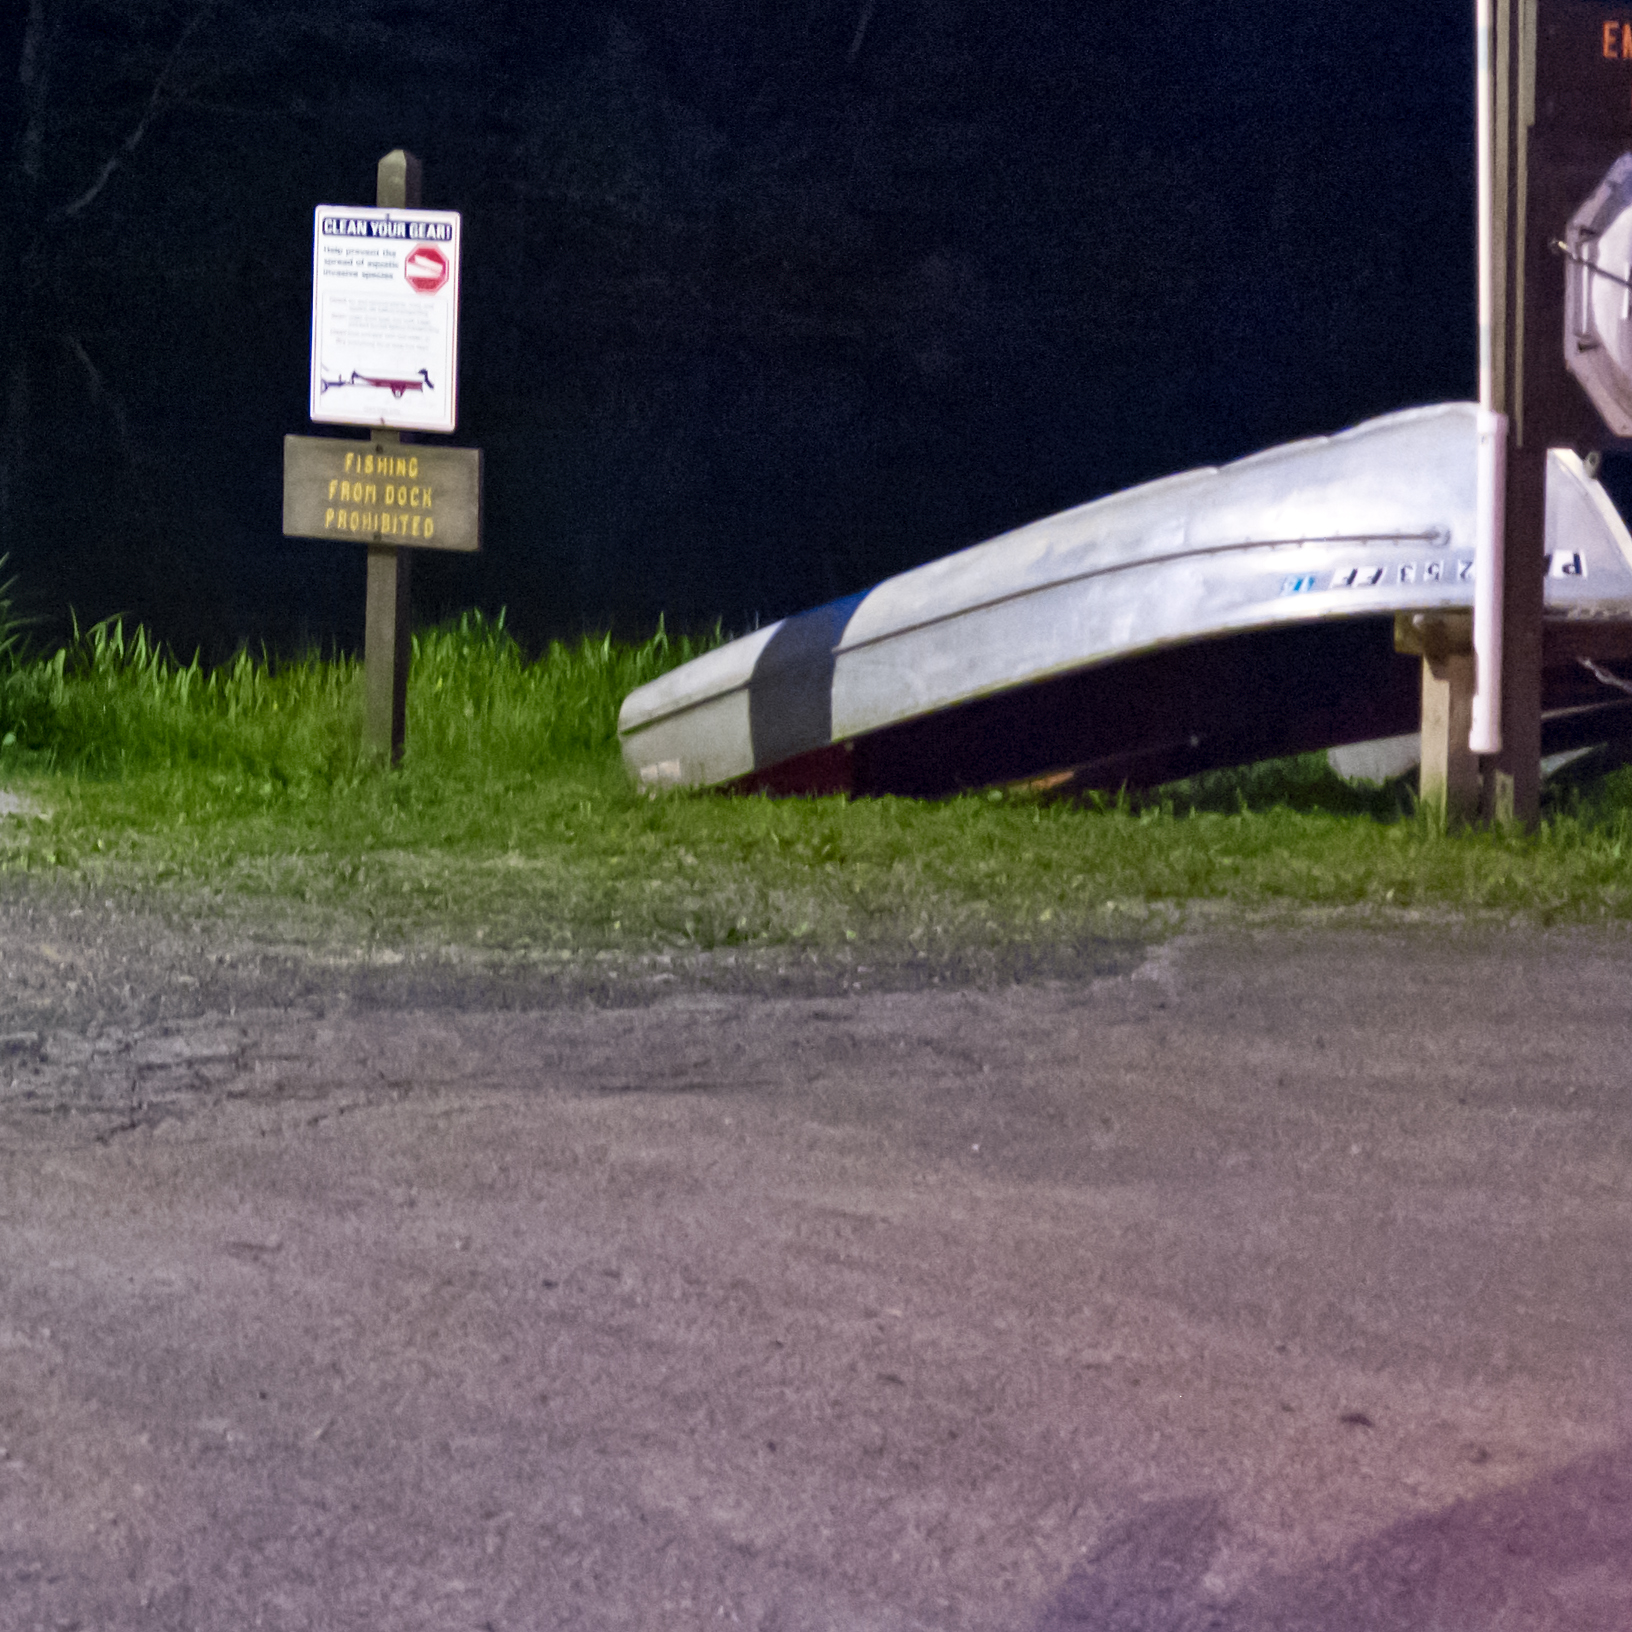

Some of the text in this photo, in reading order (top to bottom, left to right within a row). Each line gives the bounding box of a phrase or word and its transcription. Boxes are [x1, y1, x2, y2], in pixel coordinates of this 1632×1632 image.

[324, 217, 451, 240] CLEAN YOUR GEAR!
[345, 249, 379, 257] prevent
[356, 258, 364, 266] of
[344, 452, 419, 479] FISHING
[327, 479, 432, 509] FROM DOCK
[324, 507, 435, 539] PROHIBITED
